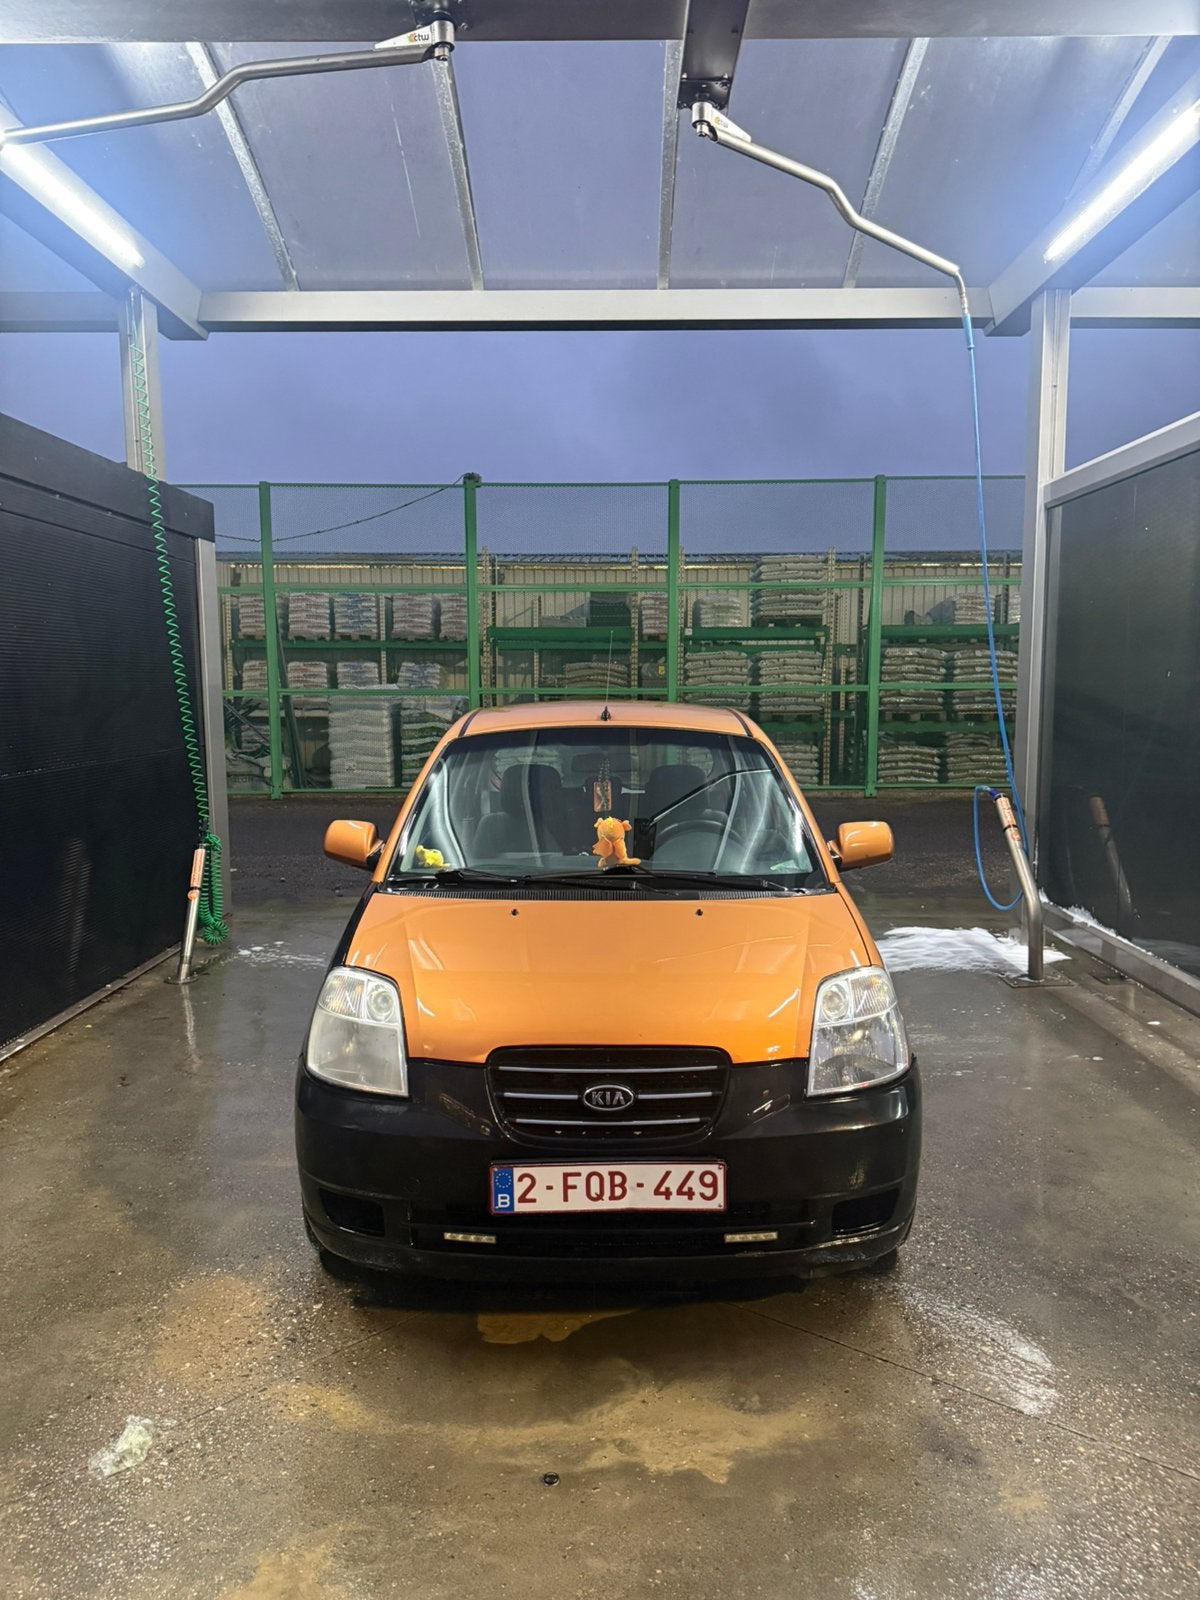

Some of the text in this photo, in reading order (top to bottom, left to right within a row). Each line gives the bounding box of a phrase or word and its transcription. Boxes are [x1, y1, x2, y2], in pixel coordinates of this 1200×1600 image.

[591, 1091, 626, 1105] KIA
[497, 1170, 719, 1208] B 2-FQB-449
